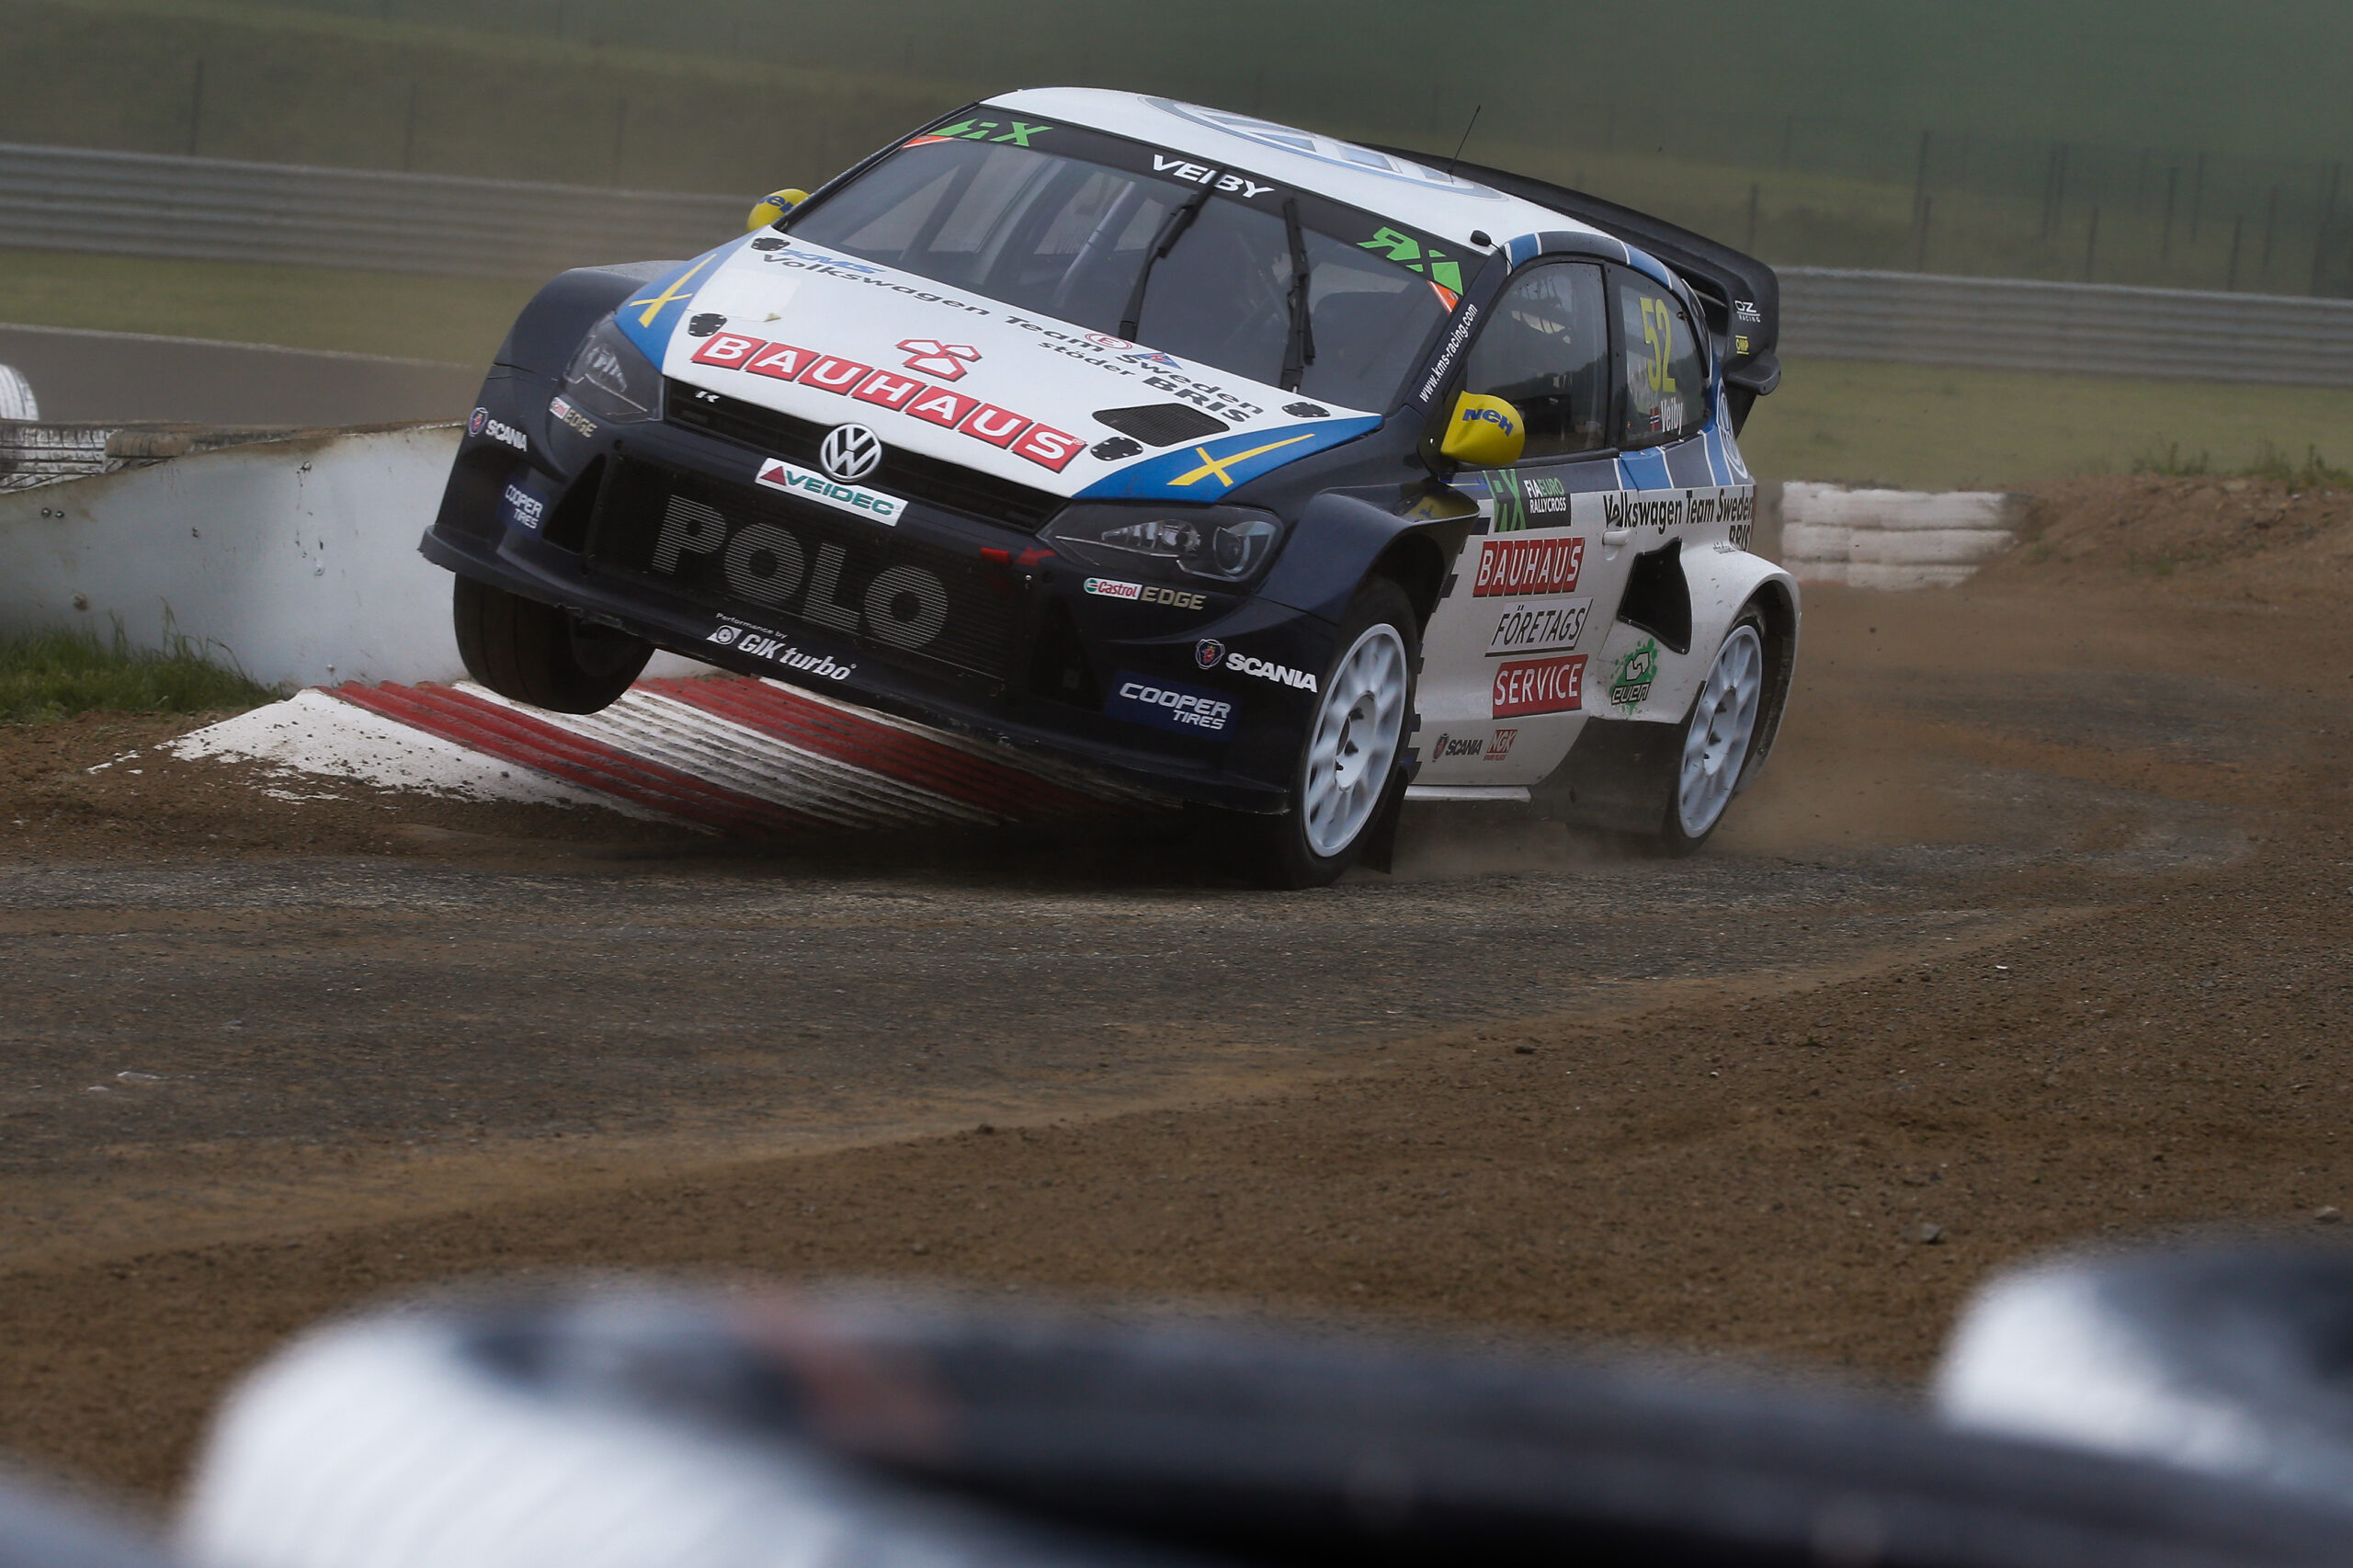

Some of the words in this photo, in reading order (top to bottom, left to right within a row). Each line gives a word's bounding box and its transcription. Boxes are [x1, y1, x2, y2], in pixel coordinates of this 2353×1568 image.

[1153, 153, 1276, 199] VEIBY
[1734, 300, 1757, 313] OZ
[763, 254, 991, 316] Volkswagen
[1004, 315, 1106, 353] Team
[1114, 353, 1266, 415] Sweden
[1418, 303, 1479, 403] www.kms-racing.com
[1639, 296, 1677, 393] 52
[701, 336, 1074, 466] BAUHAUS
[1038, 341, 1137, 376] stöder
[1142, 375, 1253, 424] BRIS
[485, 419, 529, 452] SCANIA
[563, 408, 598, 438] EDGE
[1660, 396, 1684, 436] Veiby
[505, 483, 544, 517] COOPER
[786, 470, 894, 516] VEIDEC
[1529, 497, 1567, 514] RALLYCROSS
[1603, 491, 1683, 535] Volkswagen
[1685, 489, 1715, 524] Team
[651, 494, 949, 650] POLO
[1477, 545, 1582, 586] BAUHAUS
[1097, 581, 1138, 598] Castrol
[1141, 585, 1207, 611] EDGE
[715, 612, 775, 635] Performance
[775, 630, 788, 640] by
[1491, 605, 1586, 646] FÖRETAGS
[779, 647, 851, 681] turbo
[1225, 653, 1319, 693] SCANIA
[1119, 682, 1232, 720] COOPER
[1495, 663, 1583, 706] SERVICE
[1173, 710, 1227, 730] TIRES
[1445, 739, 1483, 756] SCANIA
